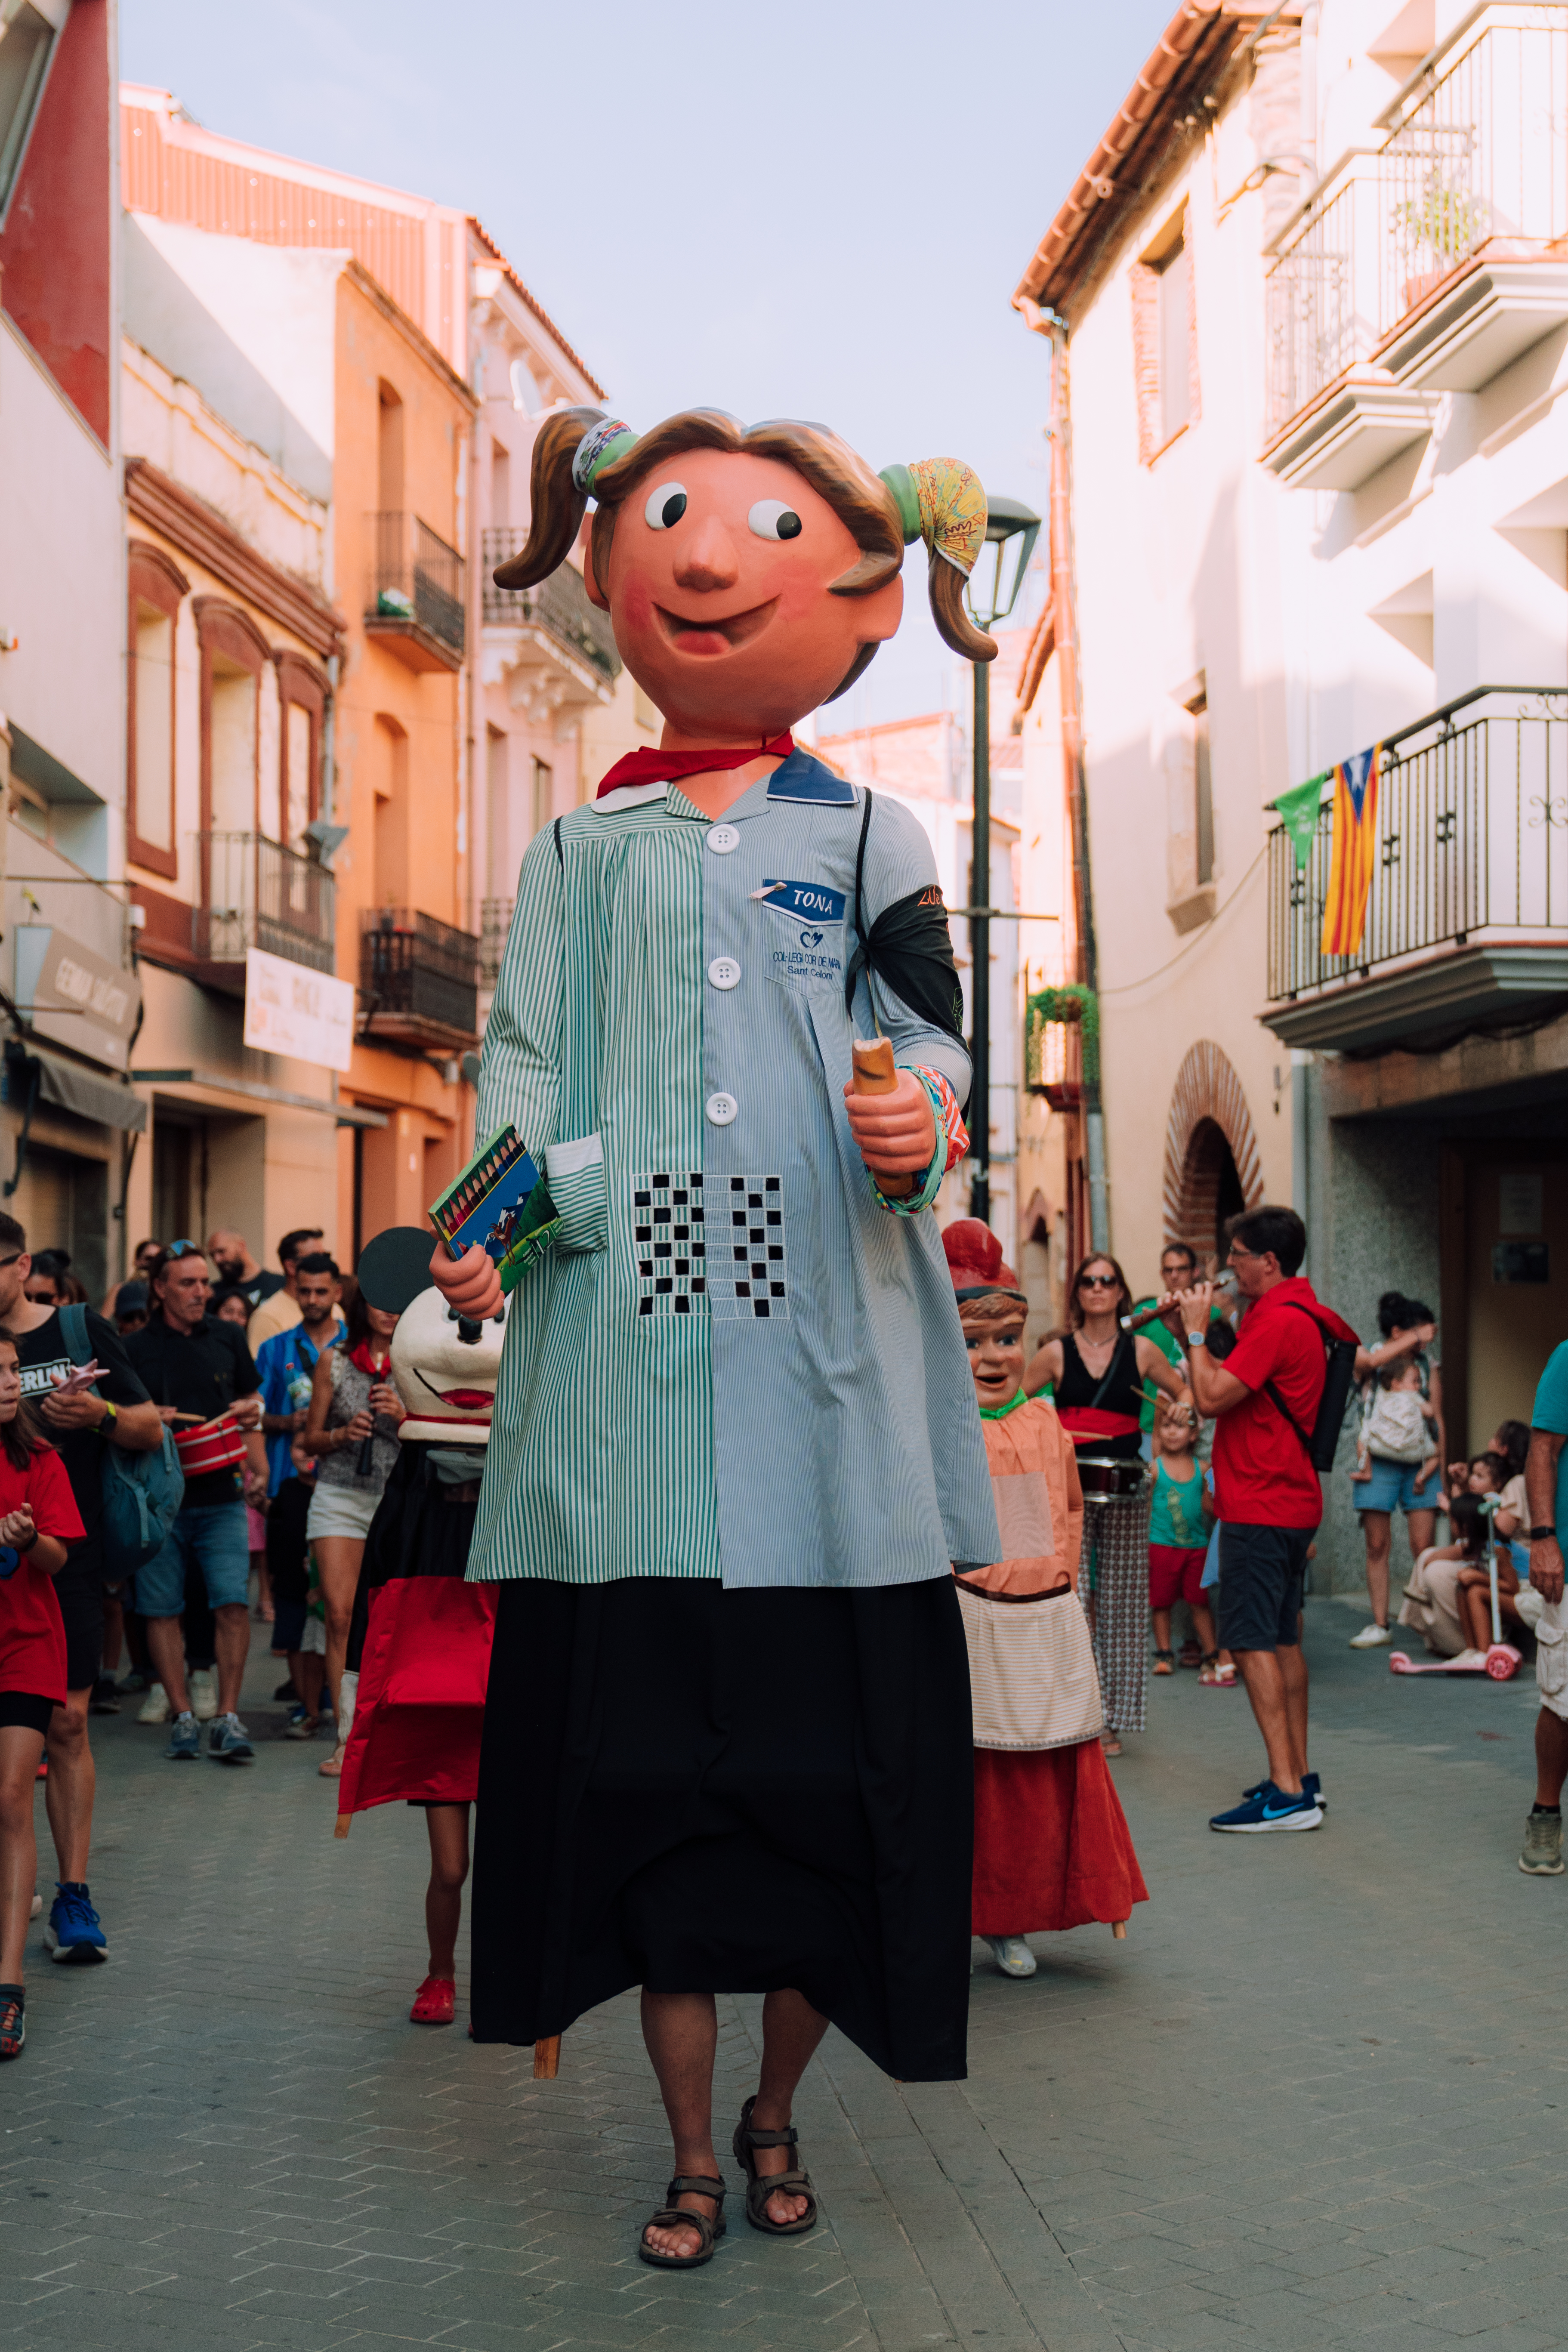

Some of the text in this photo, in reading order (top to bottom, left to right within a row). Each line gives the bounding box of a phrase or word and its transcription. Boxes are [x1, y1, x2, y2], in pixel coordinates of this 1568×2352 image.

[794, 889, 833, 915] TONA
[787, 965, 833, 980] Sant Celoni
[805, 954, 817, 966] COR
[818, 956, 827, 967] DE
[535, 1229, 554, 1254] 12
[19, 1364, 67, 1392] ERLIN
